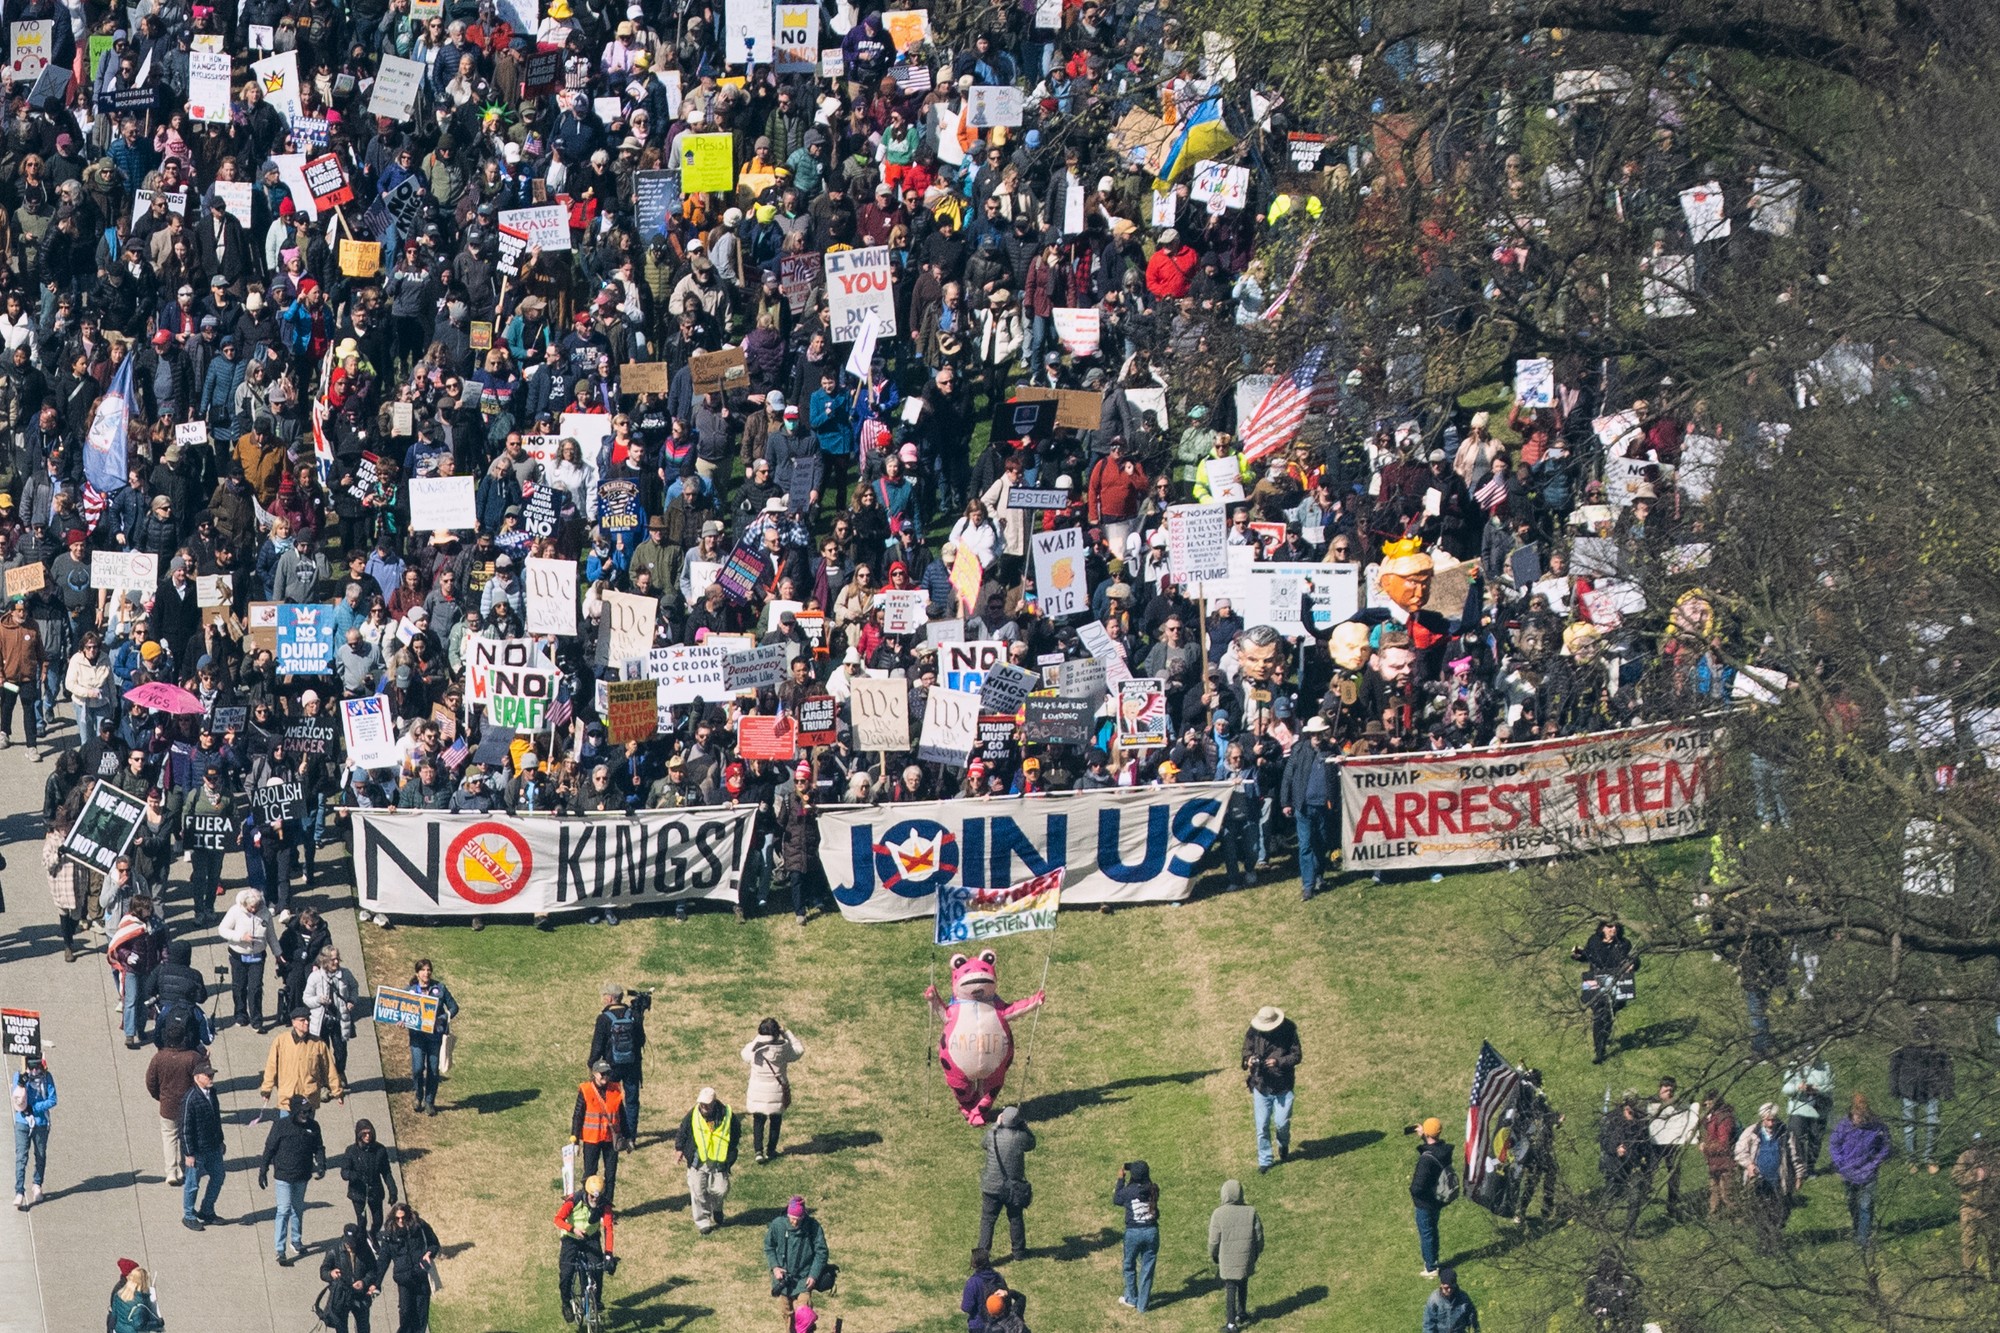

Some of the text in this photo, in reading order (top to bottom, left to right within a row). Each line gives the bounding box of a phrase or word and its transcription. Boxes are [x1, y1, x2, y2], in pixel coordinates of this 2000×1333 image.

[19, 21, 39, 32] NO
[782, 30, 806, 45] NO
[36, 46, 42, 55] A
[778, 47, 817, 63] KINGS
[528, 64, 556, 76] LARGUE
[528, 74, 554, 85] TRUMP
[116, 89, 153, 98] INDIVISIBLE
[696, 137, 730, 151] Resist
[1292, 151, 1321, 161] MUST
[324, 161, 337, 172] SE
[1298, 161, 1314, 171] GO
[308, 168, 340, 188] LARGUE
[313, 179, 342, 197] TRUMP
[535, 210, 559, 219] HERE
[536, 230, 559, 240] LOVE
[499, 242, 521, 259] MUST
[502, 253, 515, 266] GO
[828, 250, 888, 273] I WANT
[496, 261, 519, 277] NOW!
[781, 261, 794, 274] NO
[838, 271, 888, 294] YOU
[835, 322, 896, 340] PROSS
[528, 436, 544, 445] NO
[533, 492, 551, 501] ENDS
[543, 486, 553, 495] ALL
[532, 498, 552, 508] WHEN
[1009, 491, 1068, 506] EPSTEIN?
[523, 511, 558, 524] OF US SAY
[526, 504, 555, 517] ENOUGH
[1203, 507, 1224, 516] KING
[525, 518, 552, 537] NO
[602, 514, 639, 528] KINGS
[1038, 530, 1076, 554] WAR
[92, 553, 129, 564] REGIME
[735, 548, 766, 571] NO KINGS
[93, 564, 126, 576] CHANGE
[1172, 568, 1227, 583] NO TRUMP
[121, 578, 130, 586] AT
[133, 580, 157, 588] HOME
[531, 568, 570, 600] We
[723, 567, 754, 591] NO FELON
[1318, 586, 1329, 594] THE
[1044, 592, 1074, 615] PIG
[611, 603, 647, 637] We
[296, 627, 316, 637] NO
[1086, 626, 1117, 660] DUMP
[281, 643, 329, 659] DUMP
[476, 642, 527, 667] NO
[650, 646, 728, 660] NO KINGS
[730, 648, 776, 664] This What
[950, 647, 998, 670] NO
[284, 659, 327, 673] TRUMP
[651, 663, 669, 673] NO
[728, 660, 781, 675] Democracy
[736, 671, 774, 686] Looks Like
[999, 668, 1022, 681] NO
[985, 677, 1028, 697] KINGS
[610, 702, 648, 714] DUMP
[822, 699, 833, 709] SE
[854, 688, 900, 719] We
[1031, 700, 1088, 710] NUREMBERG
[800, 710, 834, 720] LARGUE
[931, 696, 972, 733] We
[1042, 712, 1079, 721] LOADING
[613, 724, 656, 741] TRUMP
[802, 721, 832, 731] TRUMP
[979, 723, 1015, 732] TRUMP
[284, 727, 333, 740] AMERICA'S
[811, 734, 825, 742] YA!
[982, 732, 1011, 740] MUST
[283, 739, 325, 753] CANCER
[988, 741, 1004, 750] GO
[983, 750, 1010, 759] NOW!
[1352, 770, 1421, 789] TRUMP
[1459, 762, 1525, 780] BONDI
[1566, 747, 1632, 767] VANCE
[253, 782, 303, 806] ABOLISH
[94, 790, 141, 824] WE ARE
[264, 802, 293, 824] ICE
[1354, 780, 1550, 844] ARREST
[186, 816, 233, 832] FUERA
[194, 834, 225, 850] ICE
[71, 834, 117, 868] NOT OK
[833, 798, 1222, 907] JOIN US
[1352, 842, 1419, 860] MILLER
[463, 838, 514, 890] SINCE 1776
[556, 818, 746, 902] KINGS!
[937, 882, 968, 903] NO
[939, 901, 966, 922] NO
[938, 921, 968, 941] NO
[972, 912, 1030, 937] EPSTEIN
[379, 998, 420, 1013] FIGHT BACK
[3, 1015, 38, 1027] TRUMP
[378, 1009, 420, 1025] VOTE YES!
[7, 1025, 35, 1036] MUST
[14, 1035, 29, 1044] GO
[9, 1044, 36, 1055] NOW!
